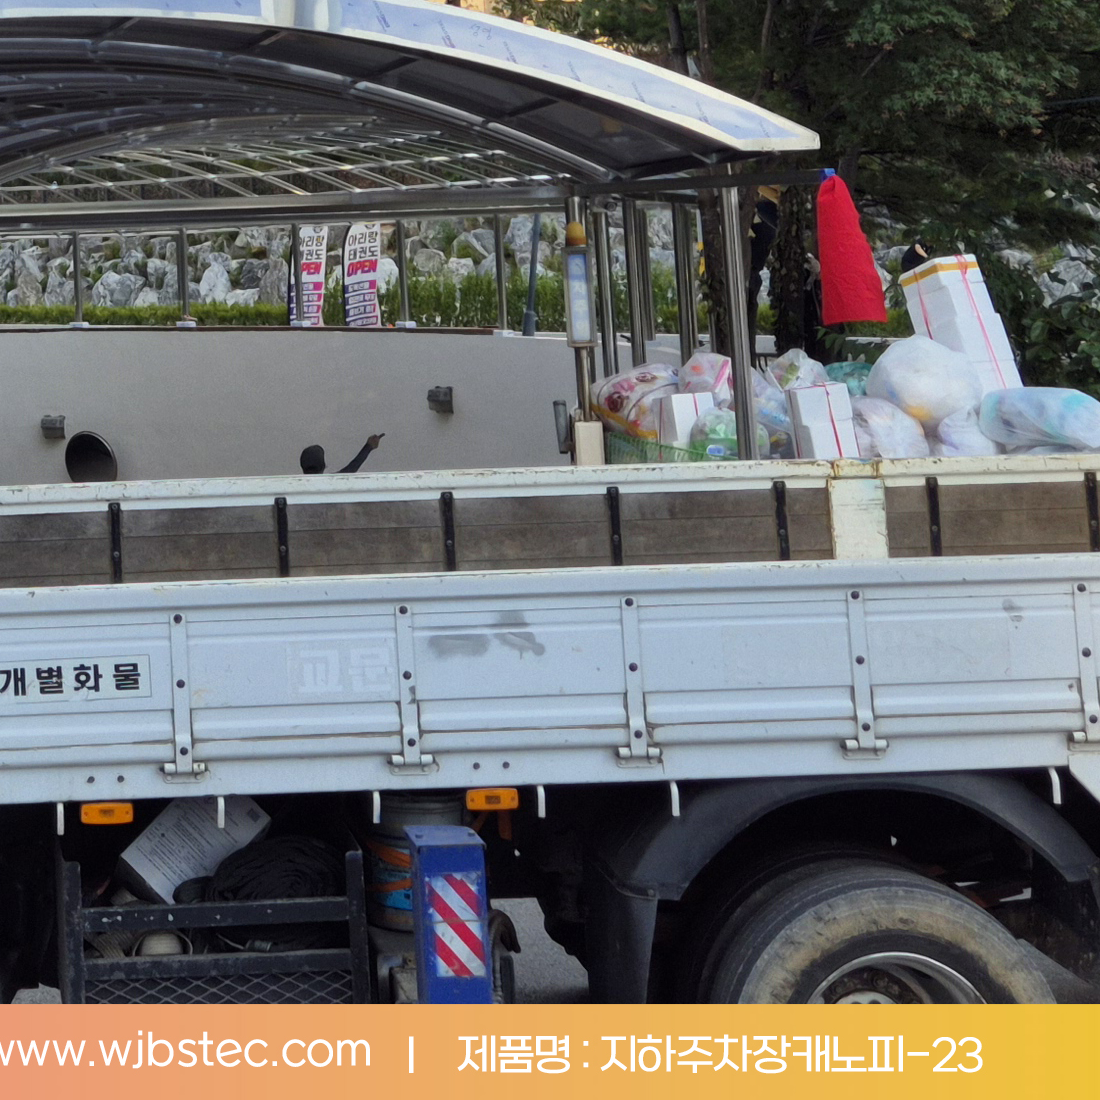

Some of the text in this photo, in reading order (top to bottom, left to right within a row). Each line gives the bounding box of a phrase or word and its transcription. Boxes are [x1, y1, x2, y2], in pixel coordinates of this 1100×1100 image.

[348, 230, 378, 247] 아리랑
[348, 245, 379, 261] 태권도
[300, 261, 323, 276] PEN
[346, 258, 378, 278] OPEN
